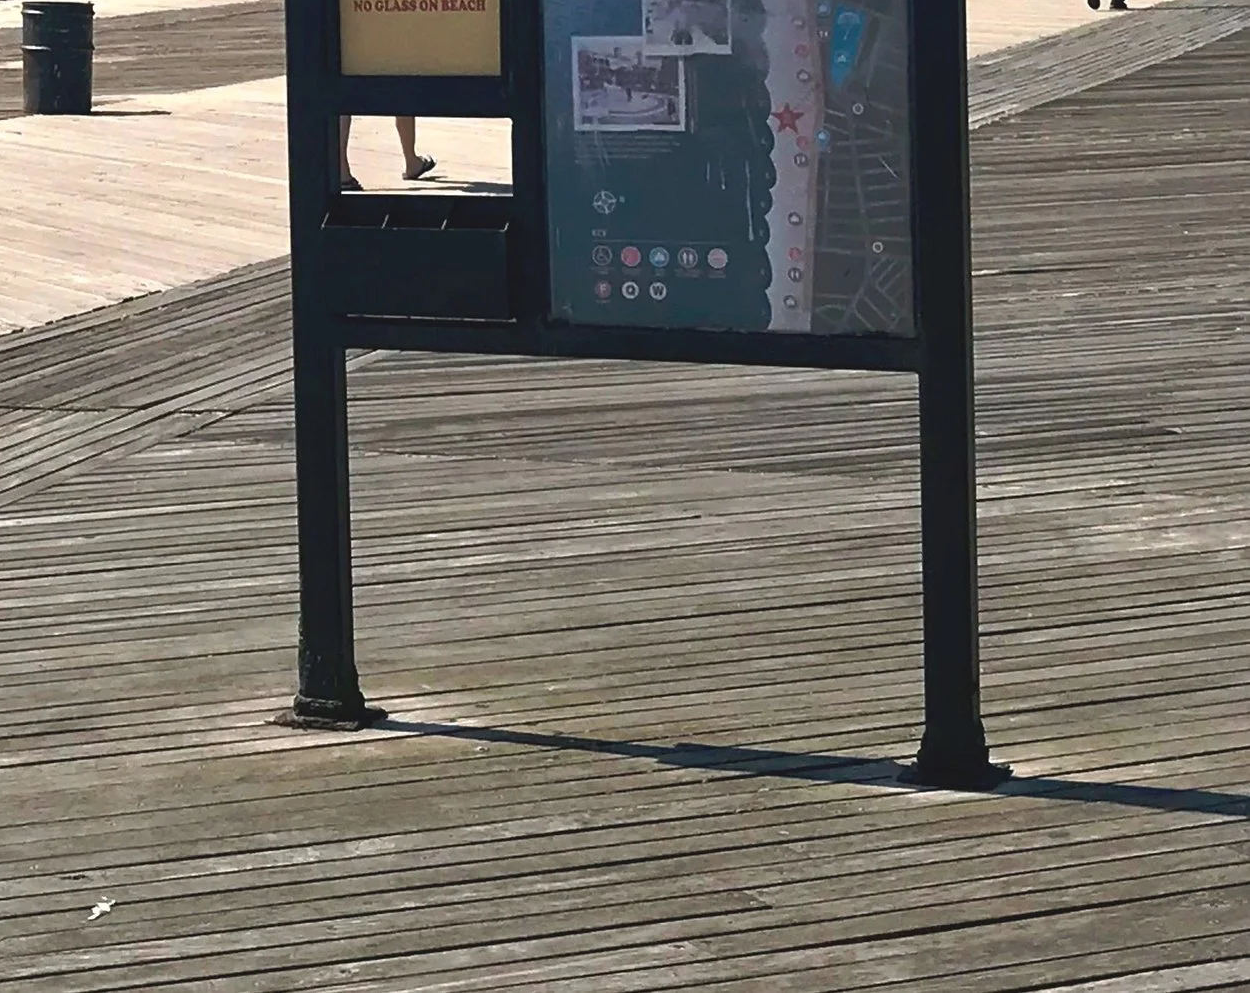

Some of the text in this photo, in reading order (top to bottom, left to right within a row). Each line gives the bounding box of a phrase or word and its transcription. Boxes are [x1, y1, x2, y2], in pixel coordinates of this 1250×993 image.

[353, 0, 372, 12] NO
[375, 0, 417, 12] GLASS
[420, 0, 439, 12] ON
